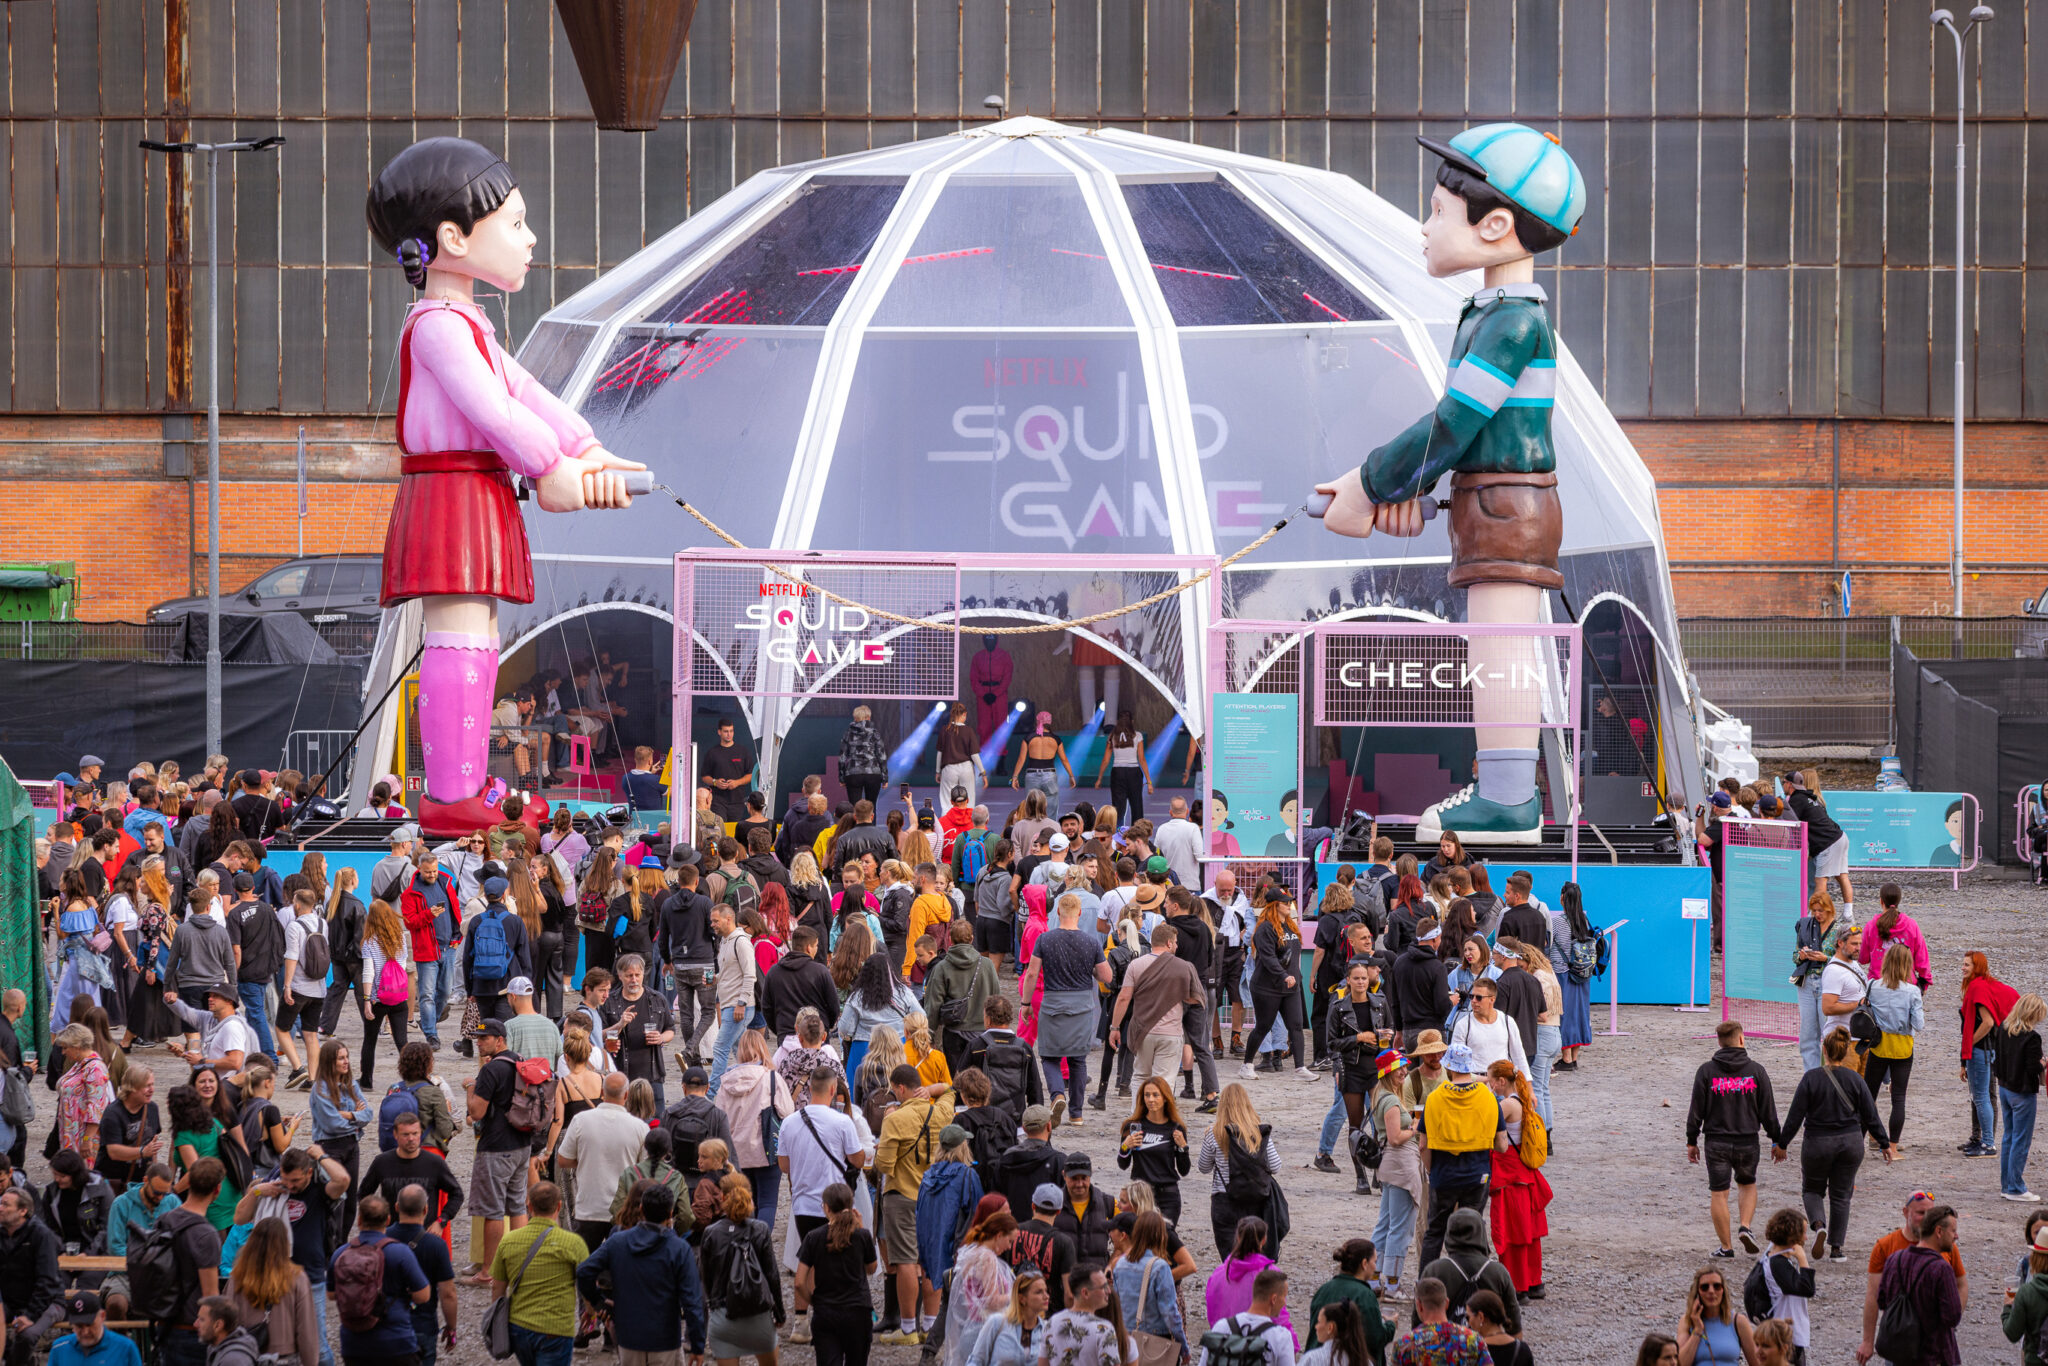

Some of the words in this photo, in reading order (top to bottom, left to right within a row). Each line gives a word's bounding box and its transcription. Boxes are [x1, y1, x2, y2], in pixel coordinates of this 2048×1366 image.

[984, 358, 1089, 388] NETFLIX
[927, 371, 1229, 482] SQUID
[759, 583, 809, 598] NETFLIX
[734, 590, 870, 639] SQUID
[766, 638, 896, 677] GAME
[1339, 661, 1548, 689] CHECK-IN
[1143, 1133, 1163, 1144] NIKE
